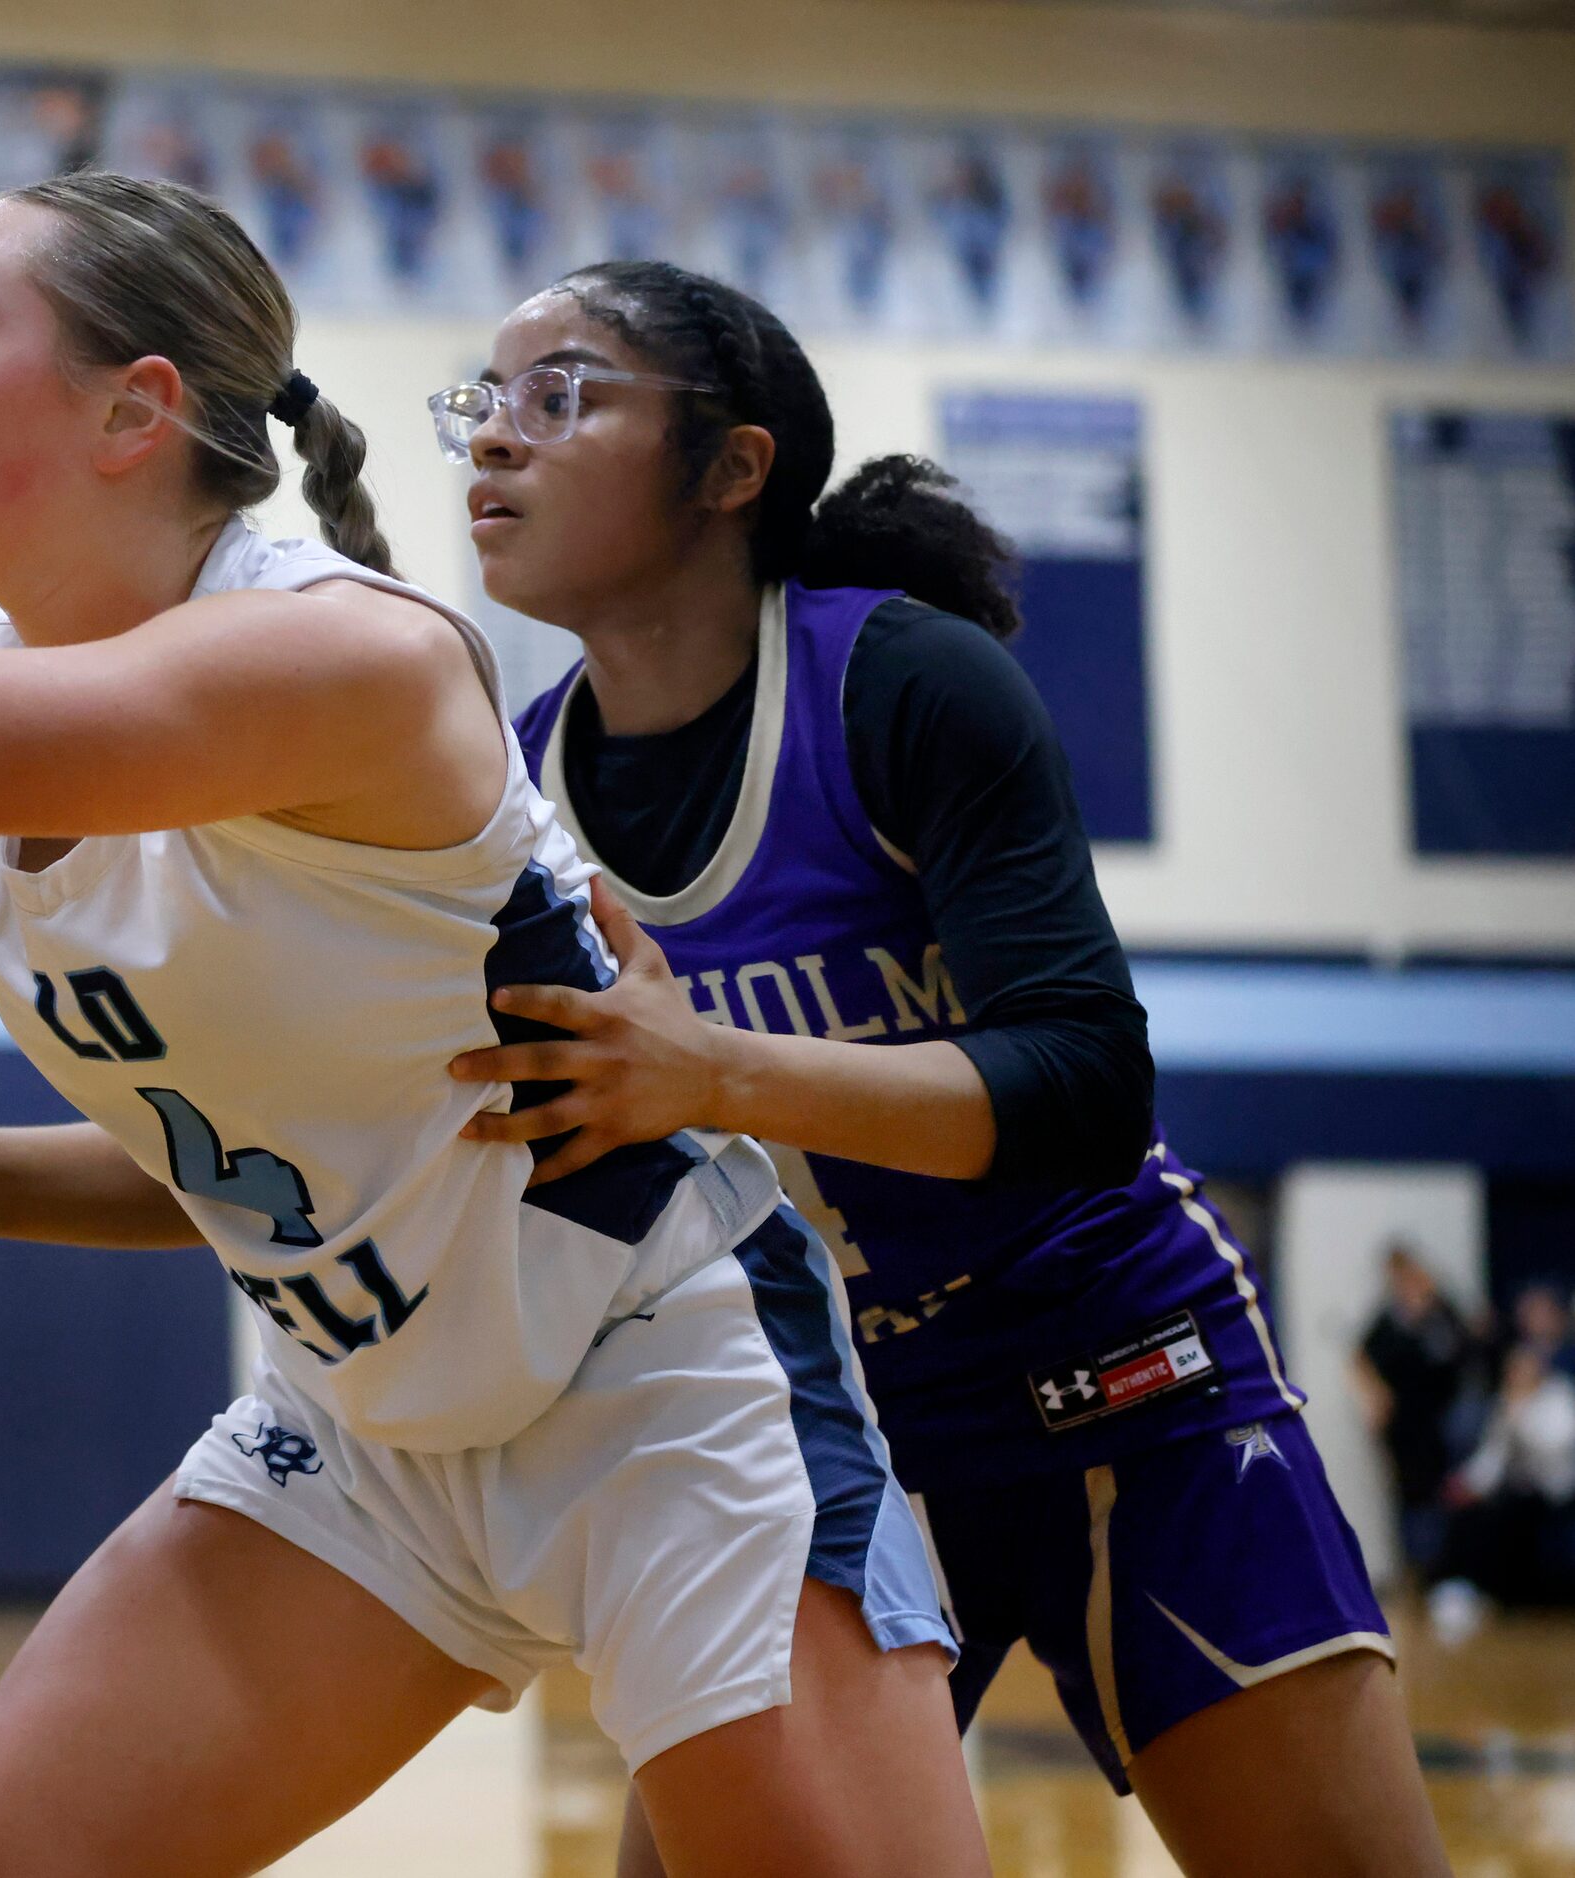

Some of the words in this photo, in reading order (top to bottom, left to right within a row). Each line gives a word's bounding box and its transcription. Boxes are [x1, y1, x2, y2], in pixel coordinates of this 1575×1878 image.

[32, 964, 168, 1063] LD
[134, 1087, 324, 1248] 4
[230, 1236, 430, 1367] ELL
[1108, 1360, 1170, 1397] AUTHENTIC
